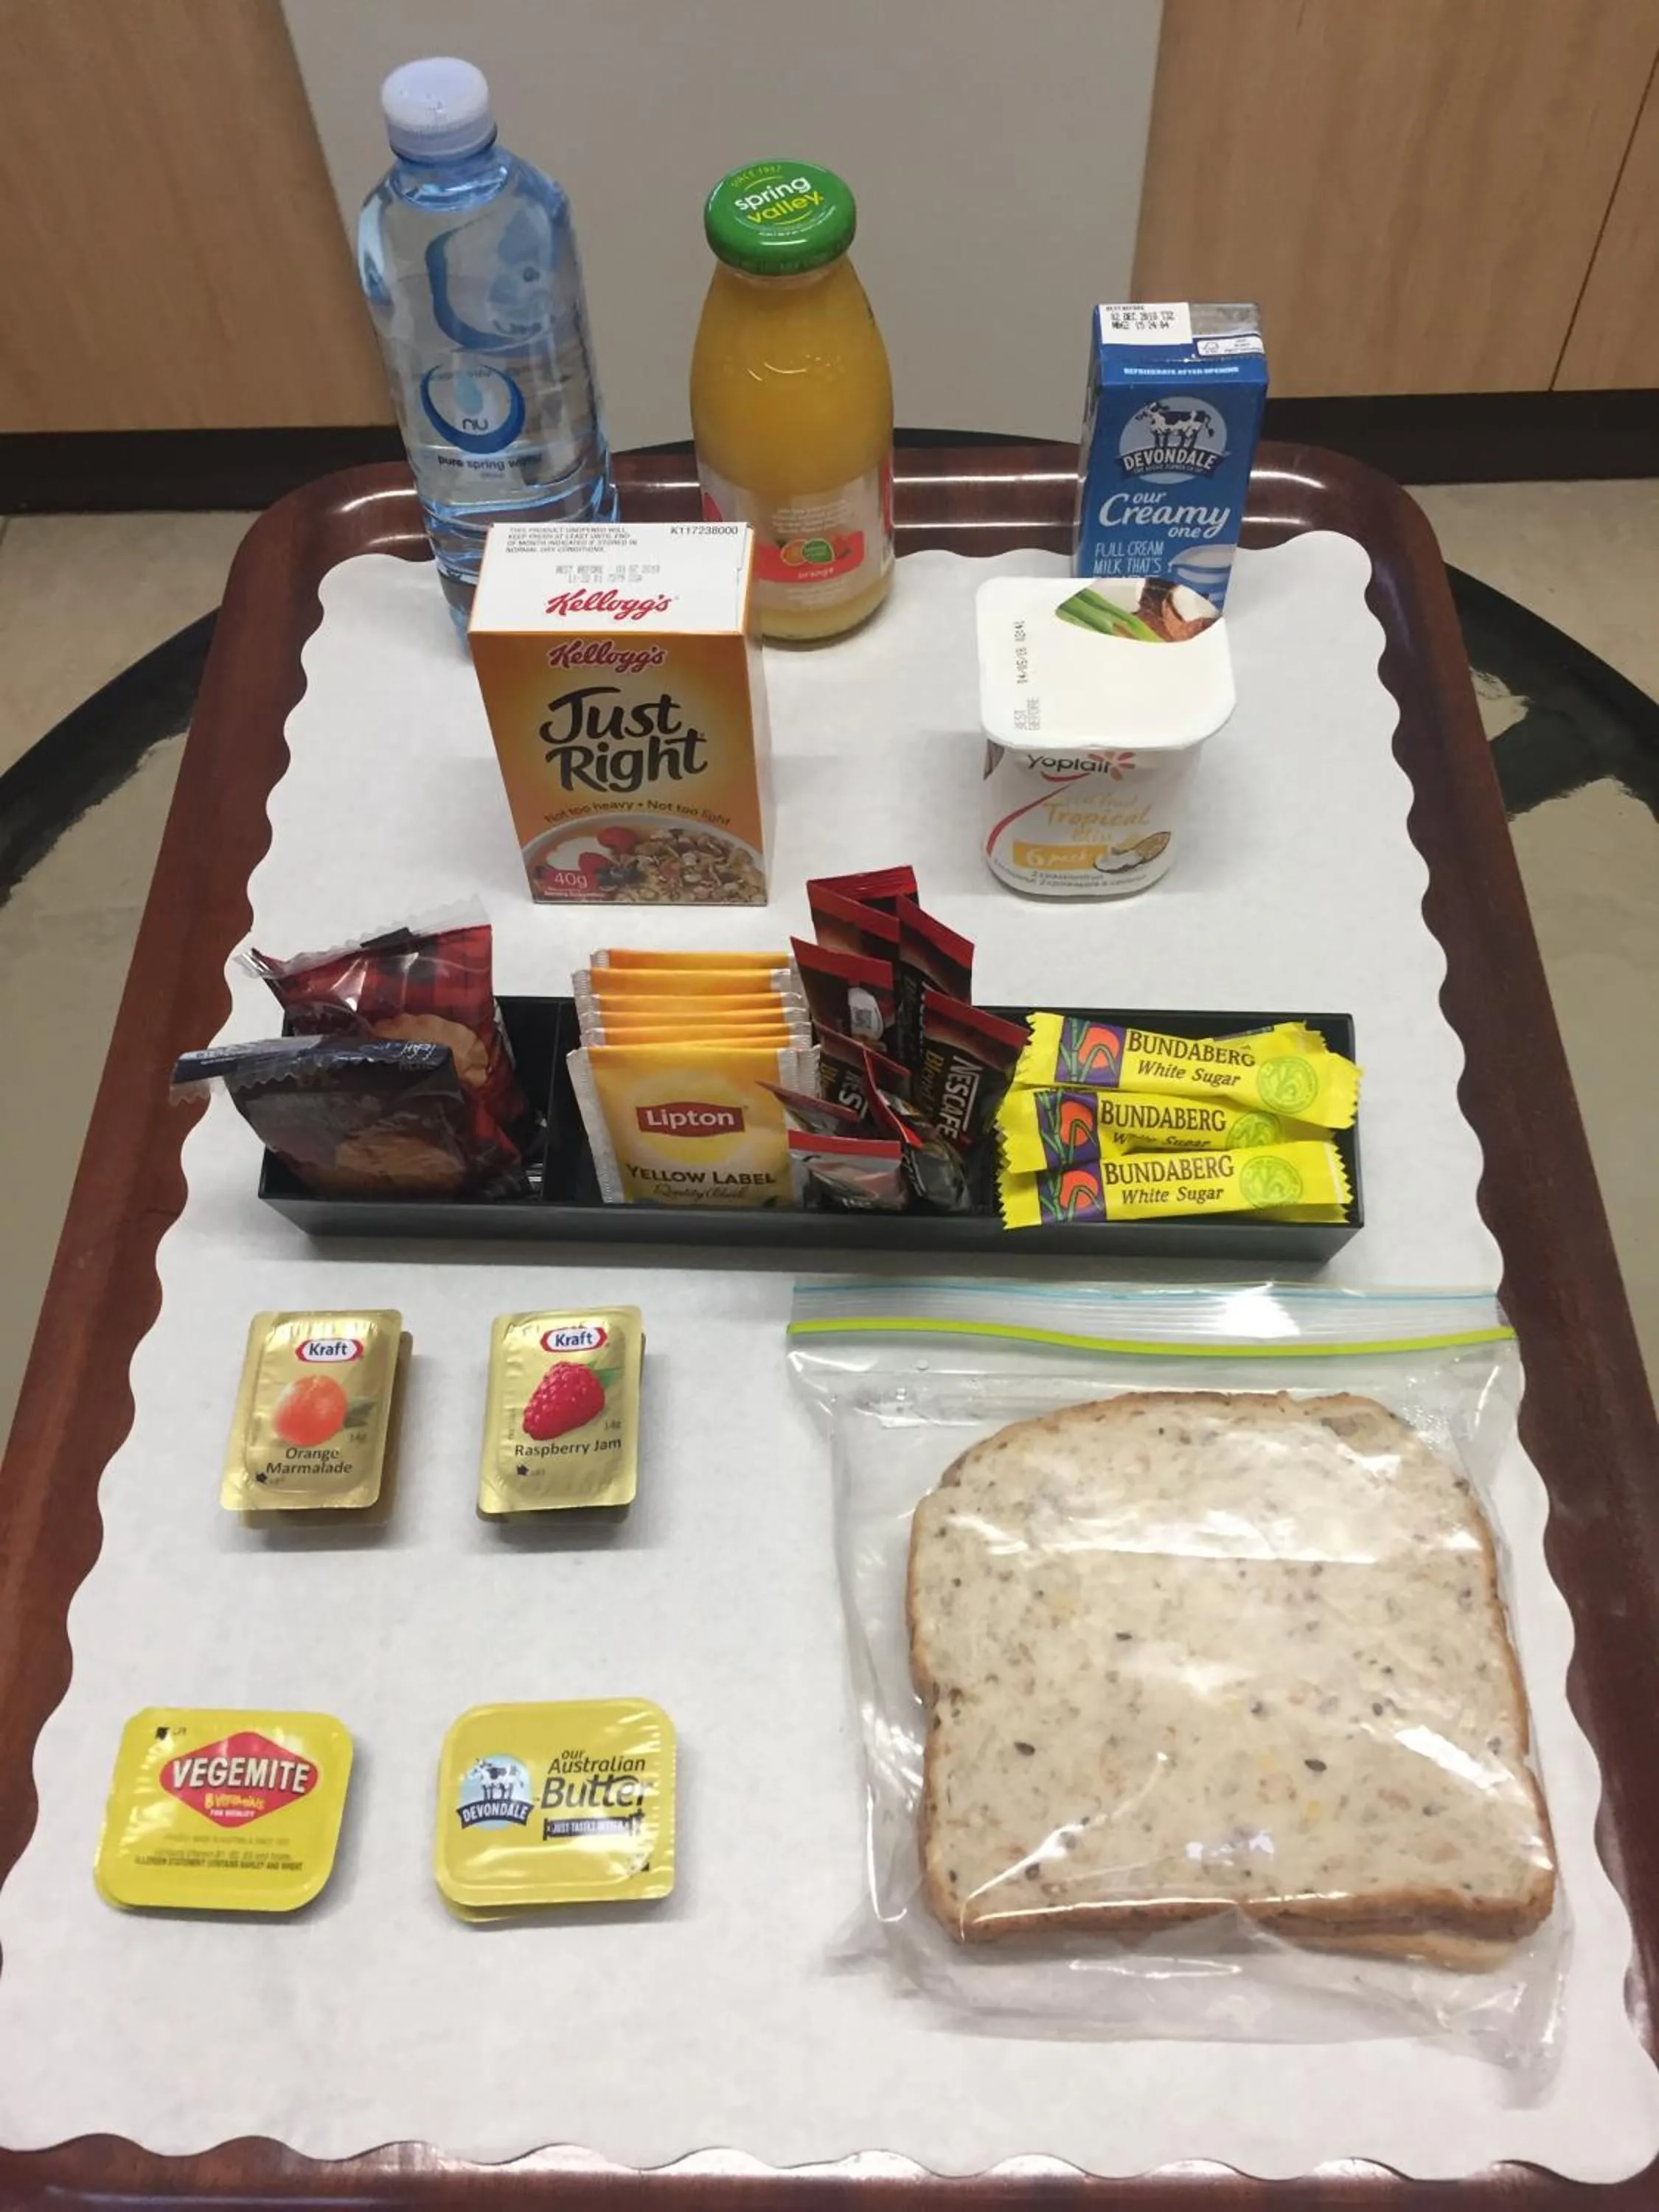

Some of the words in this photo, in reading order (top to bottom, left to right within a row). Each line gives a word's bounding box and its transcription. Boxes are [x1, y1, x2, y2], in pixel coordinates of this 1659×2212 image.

[734, 176, 811, 210] spring
[462, 418, 489, 431] nu
[437, 454, 465, 467] pure
[467, 459, 506, 470] spring
[1123, 448, 1218, 470] DEVONDALE
[1133, 492, 1167, 504] our
[1099, 493, 1231, 539] Creamy
[1168, 526, 1200, 538] one
[1096, 542, 1123, 557] FULL
[1127, 541, 1164, 557] CREAM
[1093, 559, 1121, 574] MILK
[1127, 557, 1162, 574] THAT'S
[546, 588, 672, 620] Kellogg's
[549, 641, 664, 672] Kellogg's
[539, 686, 683, 745] Just
[544, 727, 709, 793] Right
[543, 812, 568, 823] Not
[568, 804, 591, 815] too
[594, 800, 634, 812] heavy
[647, 799, 672, 811] Not
[676, 804, 699, 815] too
[703, 809, 731, 826] light
[1043, 802, 1152, 831] Tropical
[554, 872, 588, 888] 40g
[1127, 1031, 1256, 1068] BUNDABERG
[1136, 1059, 1187, 1082] White
[1191, 1067, 1242, 1088] Sugar
[647, 1108, 735, 1130] Lipton
[1099, 1099, 1227, 1133] BUNDABERG
[625, 1164, 705, 1183] YELLOW
[712, 1172, 776, 1186] LABEL
[1103, 1155, 1235, 1186] BUNDABERG
[1121, 1186, 1172, 1205] White
[1176, 1186, 1225, 1204] Sugar
[309, 1342, 349, 1356] Kraft
[554, 1331, 594, 1346] Kraft
[285, 1447, 339, 1461] Orange
[515, 1443, 590, 1458] Raspberry
[594, 1439, 622, 1451] Jam
[266, 1461, 353, 1475] Marmalade
[547, 1756, 646, 1775] Australian
[562, 1750, 586, 1760] our
[172, 1757, 311, 1794] VEGEMITE
[540, 1773, 644, 1809] Butter
[462, 1803, 529, 1823] DEVONDALE
